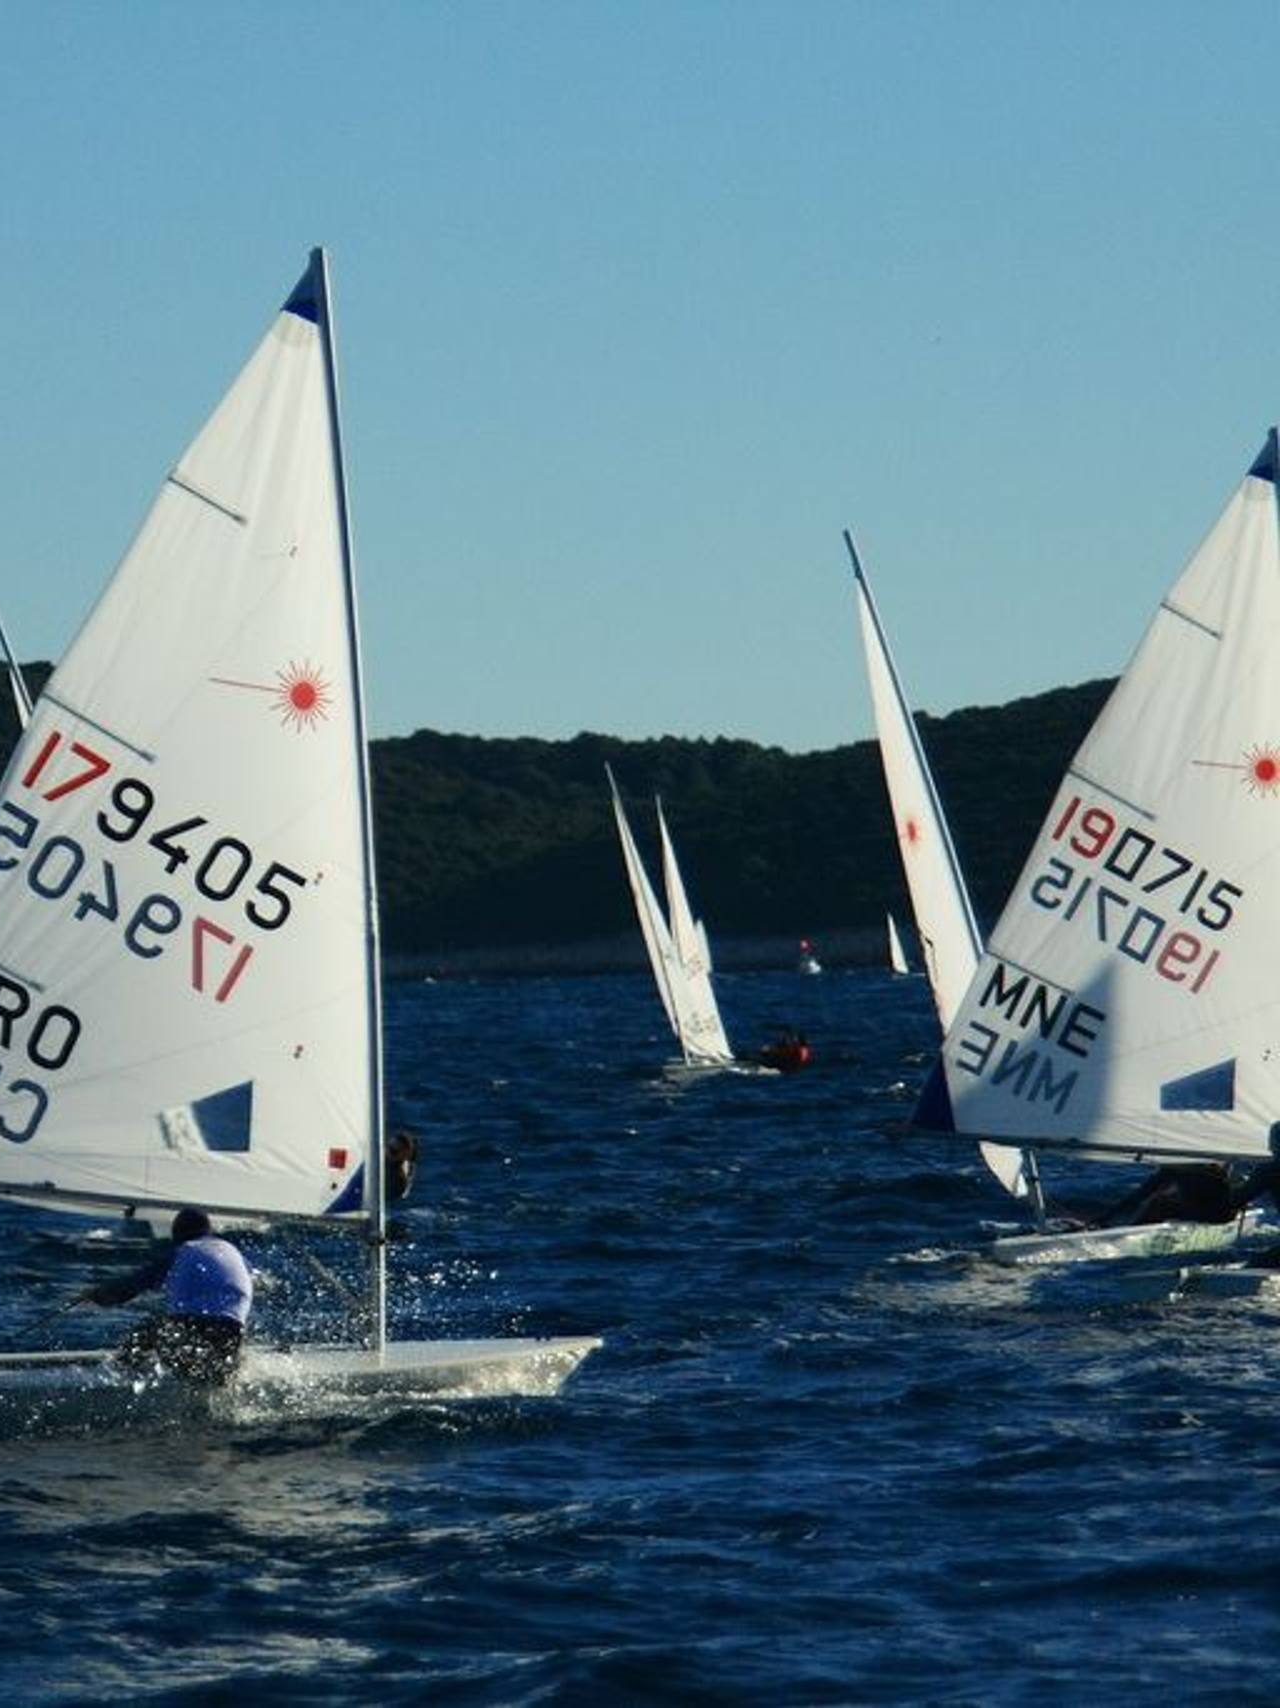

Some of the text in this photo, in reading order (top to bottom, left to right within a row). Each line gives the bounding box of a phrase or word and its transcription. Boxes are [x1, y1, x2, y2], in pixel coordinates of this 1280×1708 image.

[22, 730, 308, 930] 179405
[1052, 796, 1244, 931] 190715
[979, 962, 1106, 1058] MNE
